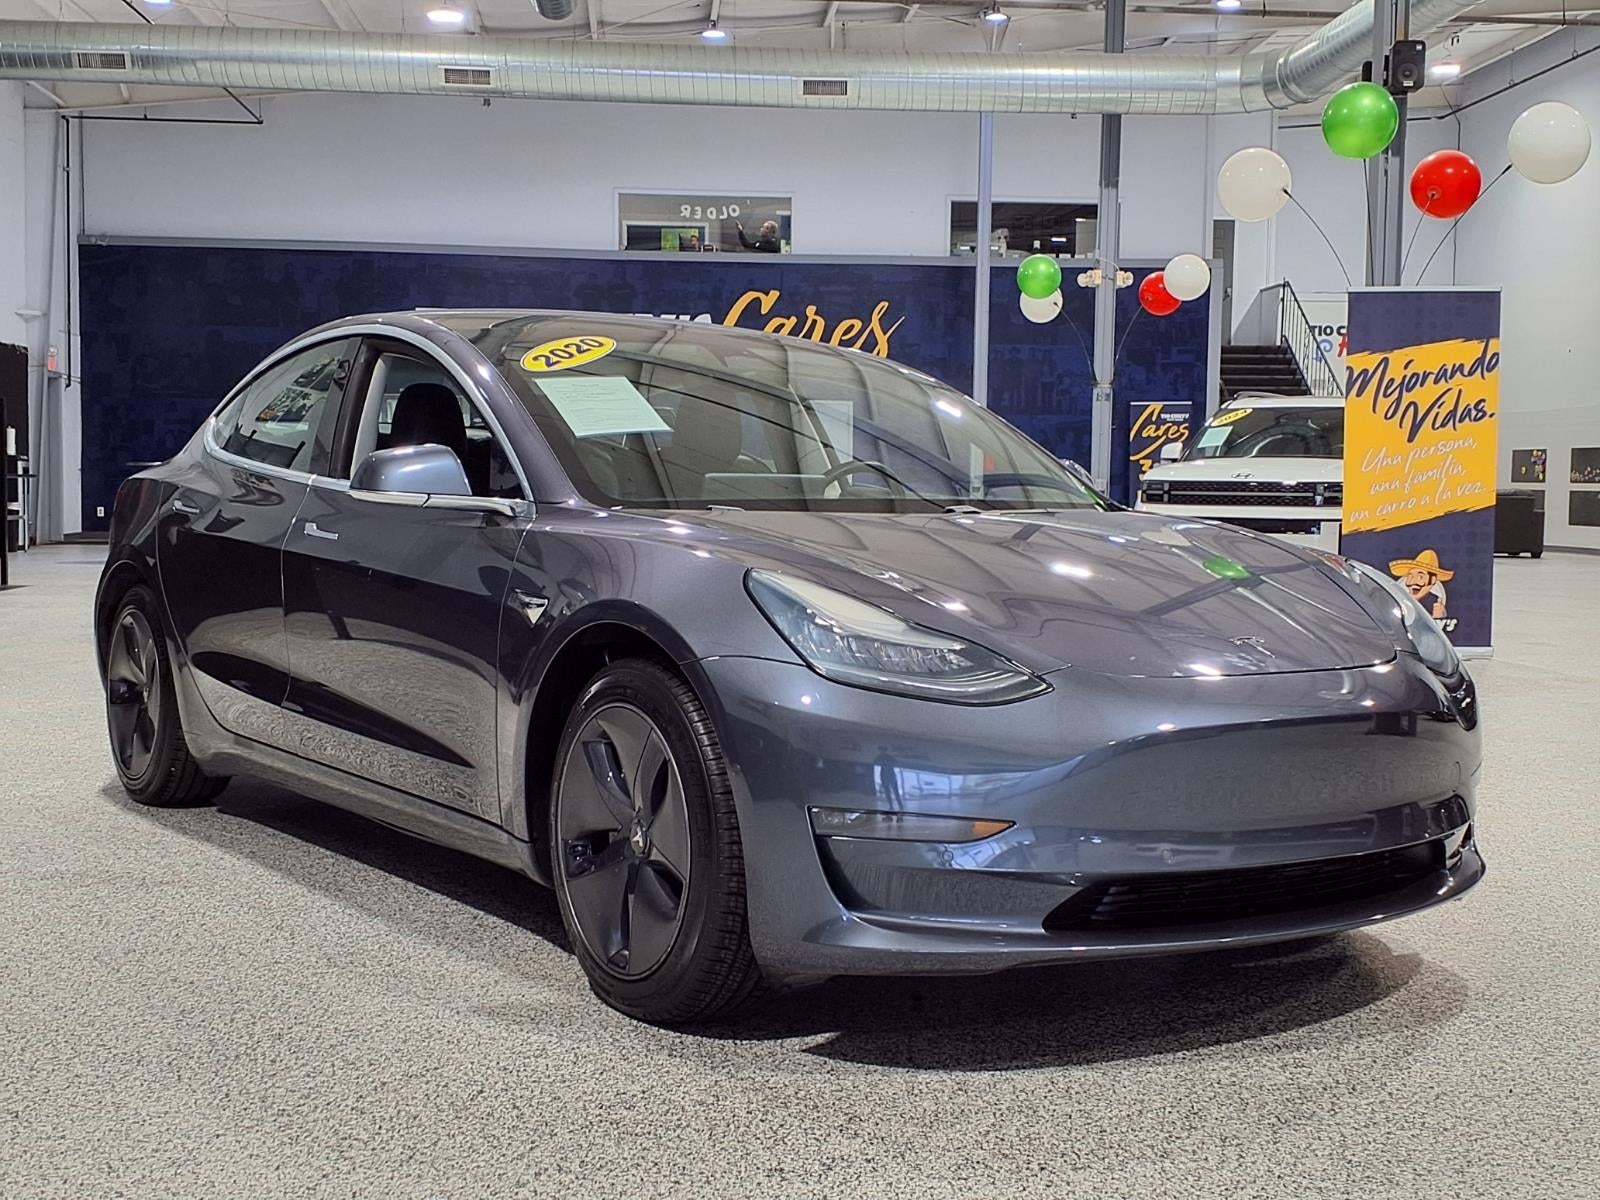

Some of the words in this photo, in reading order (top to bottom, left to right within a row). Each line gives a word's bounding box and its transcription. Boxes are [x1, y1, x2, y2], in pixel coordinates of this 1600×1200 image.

[722, 289, 906, 359] Cares
[532, 337, 605, 368] 2020
[1345, 338, 1500, 421] Mejorando
[1361, 446, 1402, 475] Una
[1404, 437, 1478, 473] persona,
[1350, 509, 1369, 523] un
[1376, 498, 1417, 516] carro
[1420, 496, 1430, 505] a
[1435, 479, 1452, 505] la
[1370, 480, 1400, 495] una
